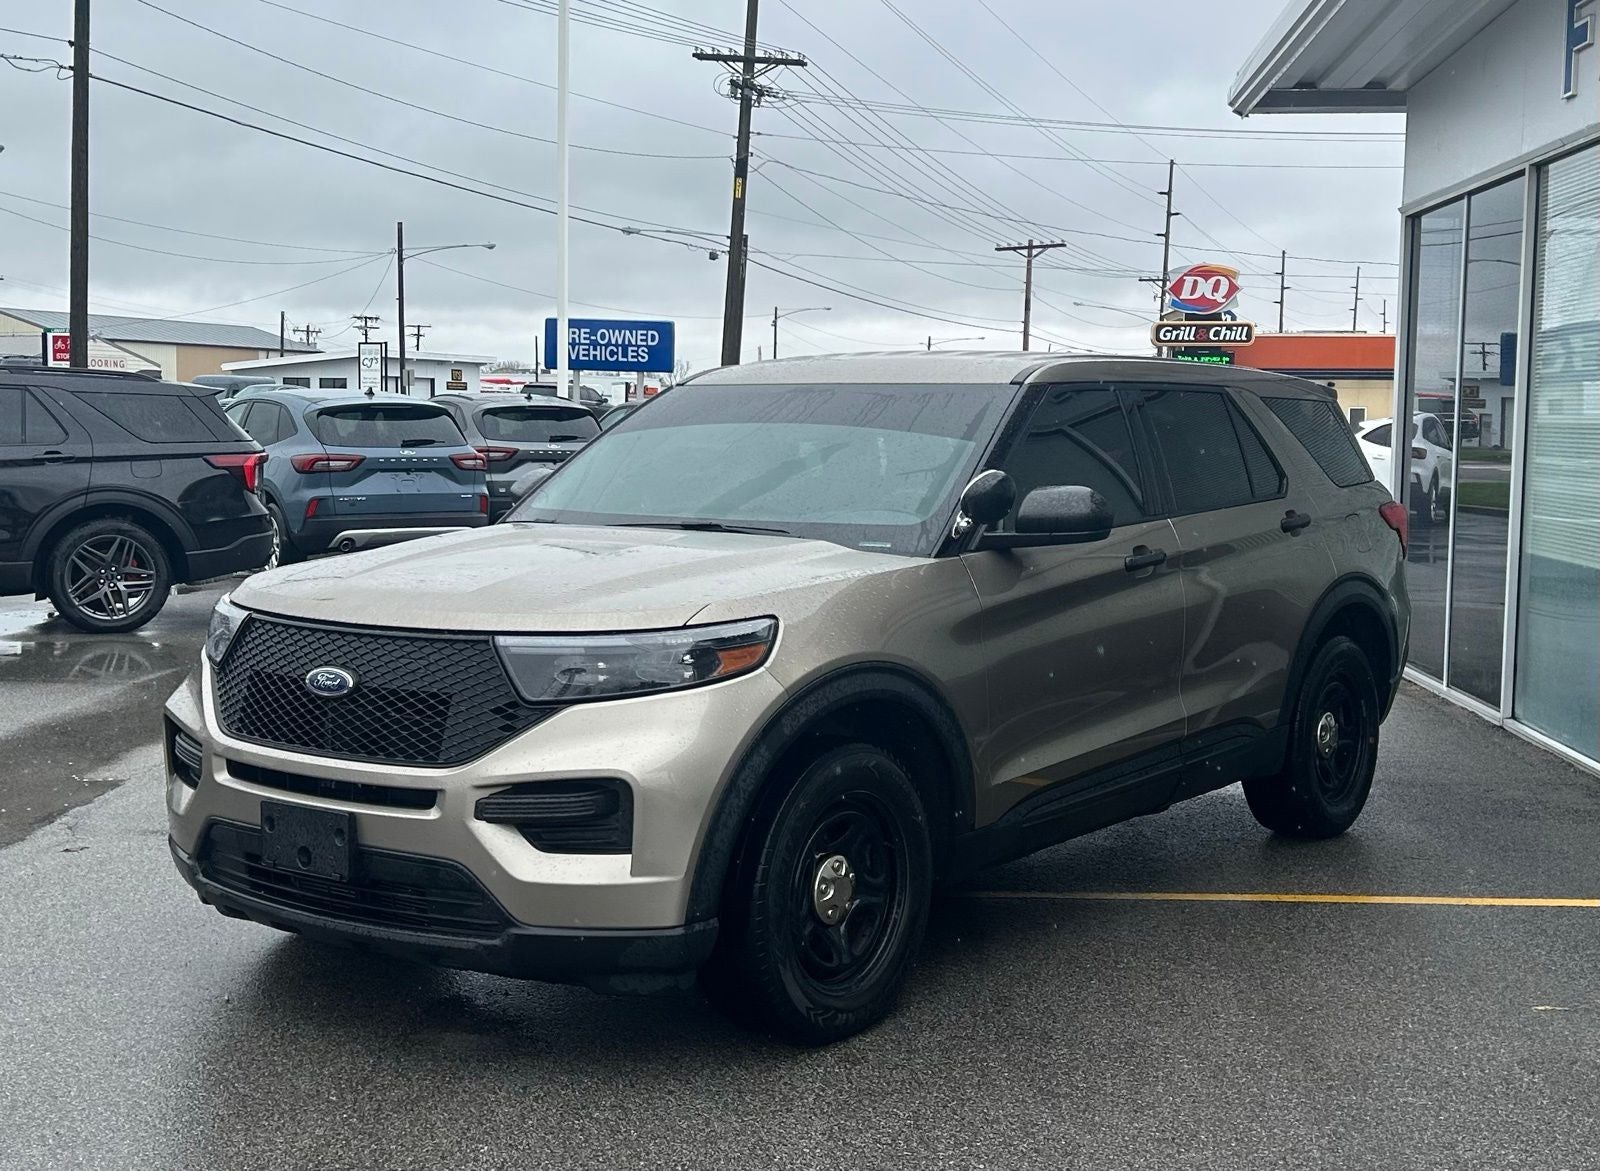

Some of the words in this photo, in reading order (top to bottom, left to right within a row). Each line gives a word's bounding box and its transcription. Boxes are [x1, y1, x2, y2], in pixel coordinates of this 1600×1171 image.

[1180, 275, 1230, 303] DQ
[568, 328, 659, 346] RE-OWNED
[1159, 326, 1197, 341] Grill
[1209, 326, 1248, 341] Chill
[568, 345, 649, 362] VEHICLES
[88, 359, 125, 368] OORING
[313, 673, 341, 690] Ford
